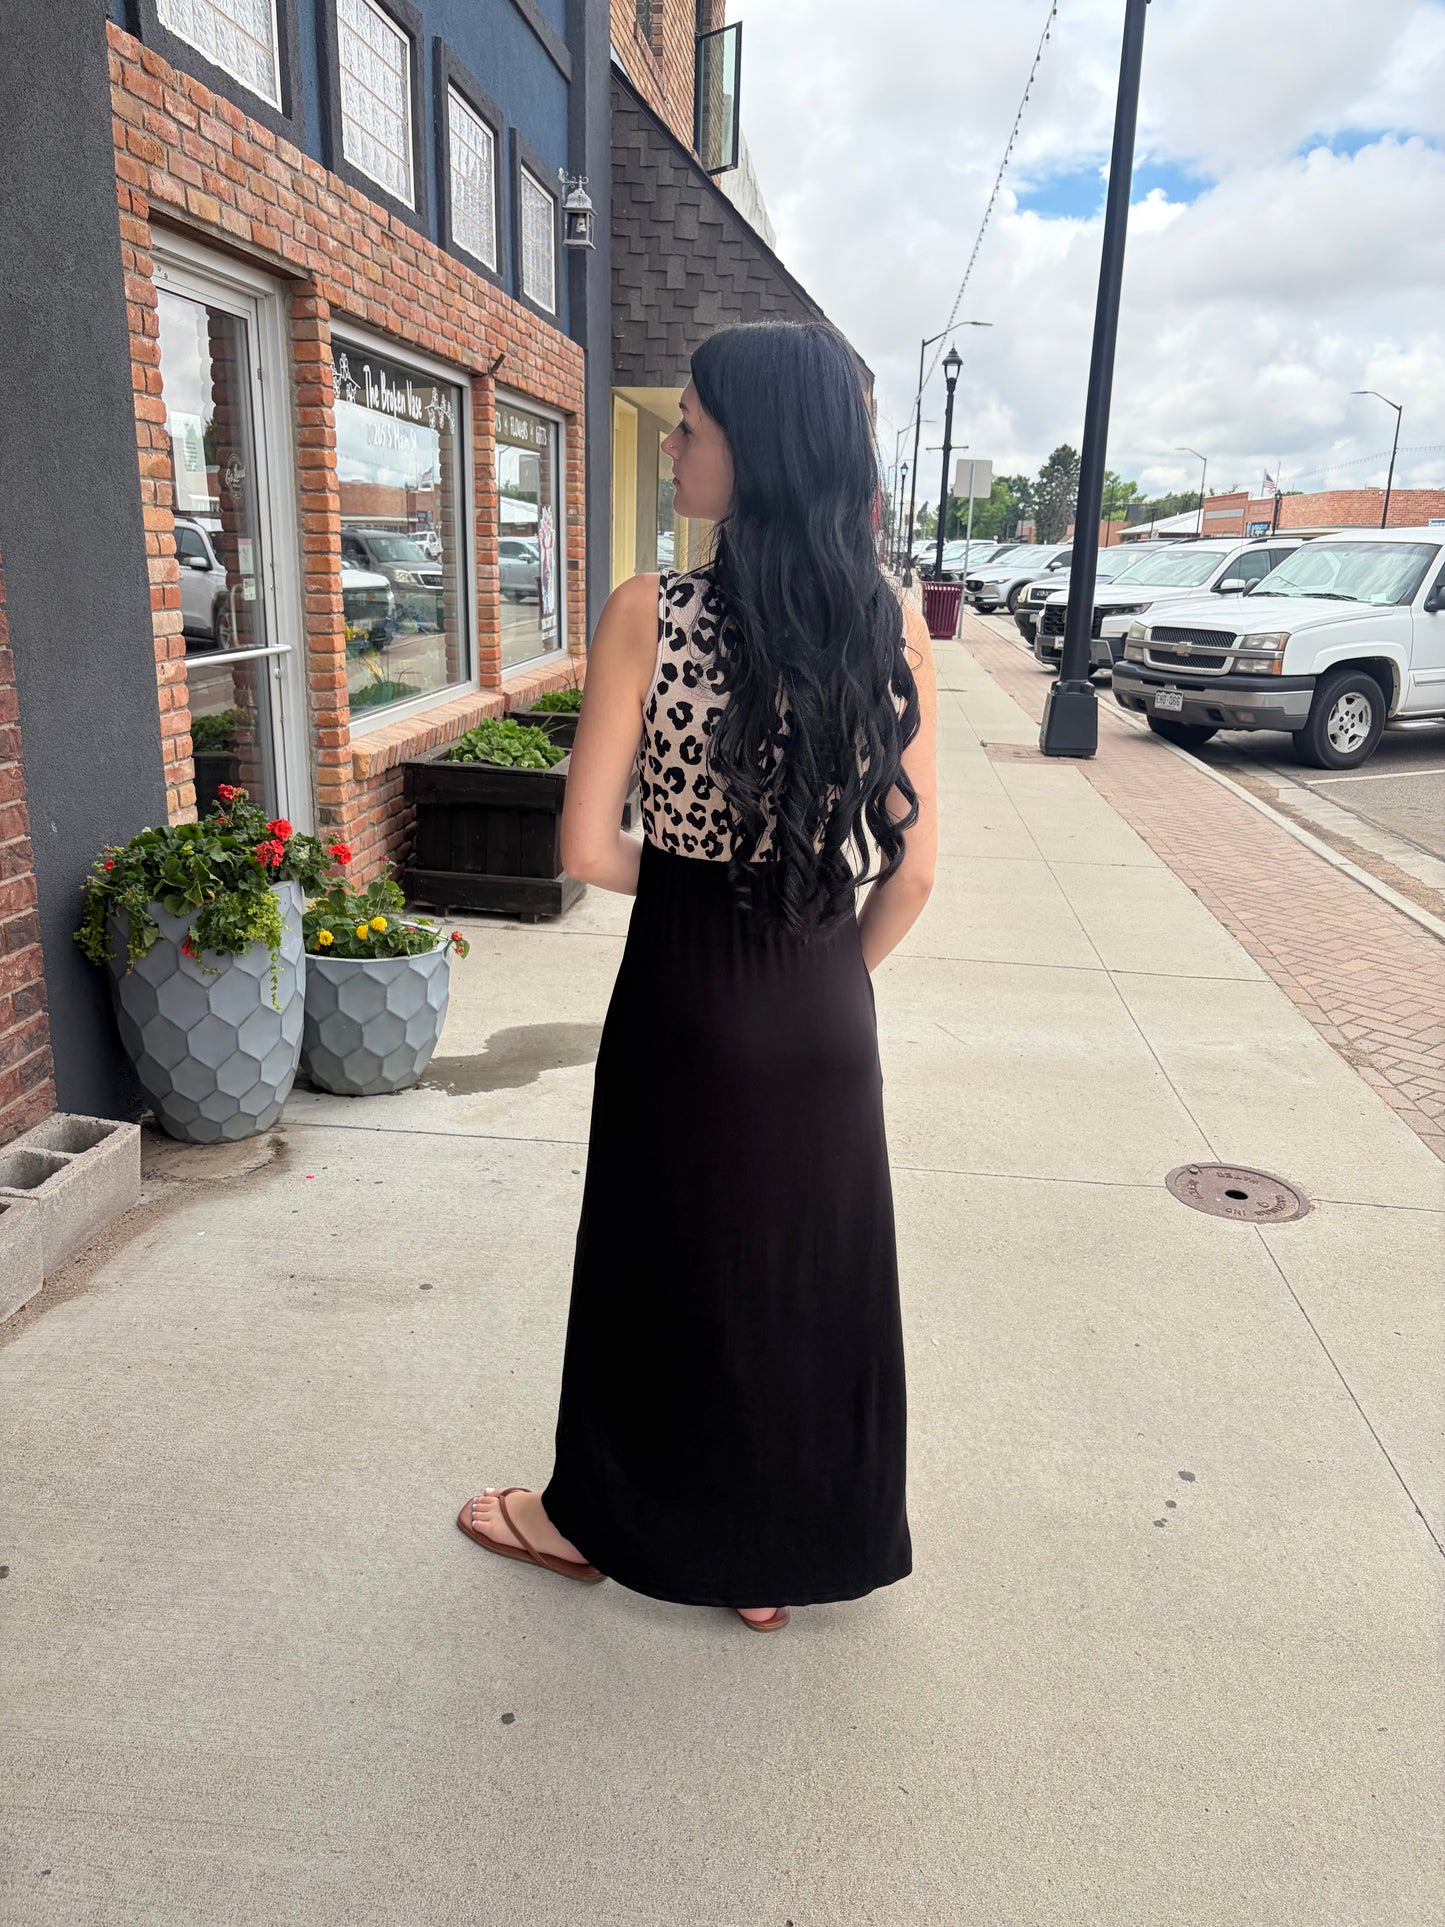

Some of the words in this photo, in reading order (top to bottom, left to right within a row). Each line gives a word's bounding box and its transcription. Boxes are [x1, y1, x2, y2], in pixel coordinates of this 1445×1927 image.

[363, 364, 380, 409] The
[380, 369, 406, 418] Broken
[406, 379, 422, 420] Vase
[387, 422, 393, 448] S
[394, 422, 409, 451] Main
[510, 415, 529, 440] FLOWERS
